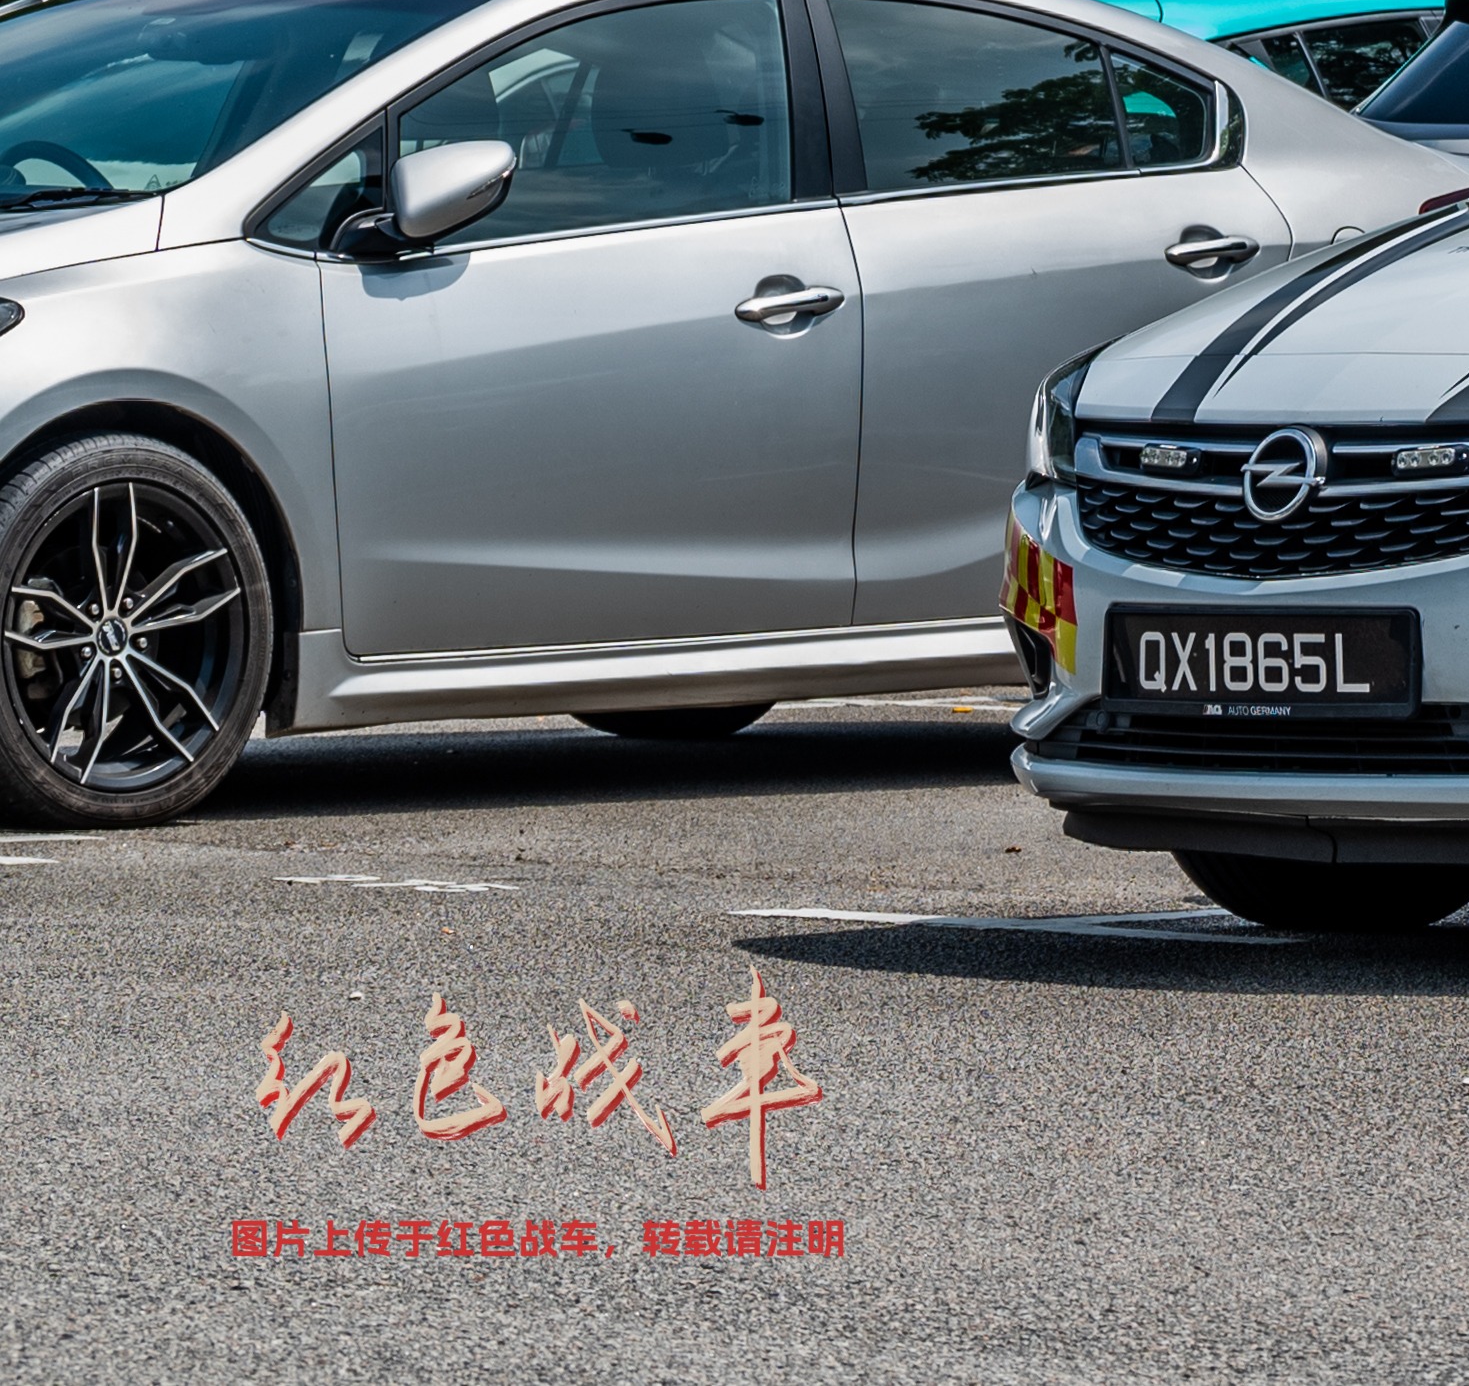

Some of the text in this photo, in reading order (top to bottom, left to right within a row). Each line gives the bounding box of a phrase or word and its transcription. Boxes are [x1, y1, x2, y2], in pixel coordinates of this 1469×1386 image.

[1139, 631, 1370, 693] QX1865L
[1228, 706, 1249, 715] AUTO
[1249, 705, 1291, 716] GERMANY
